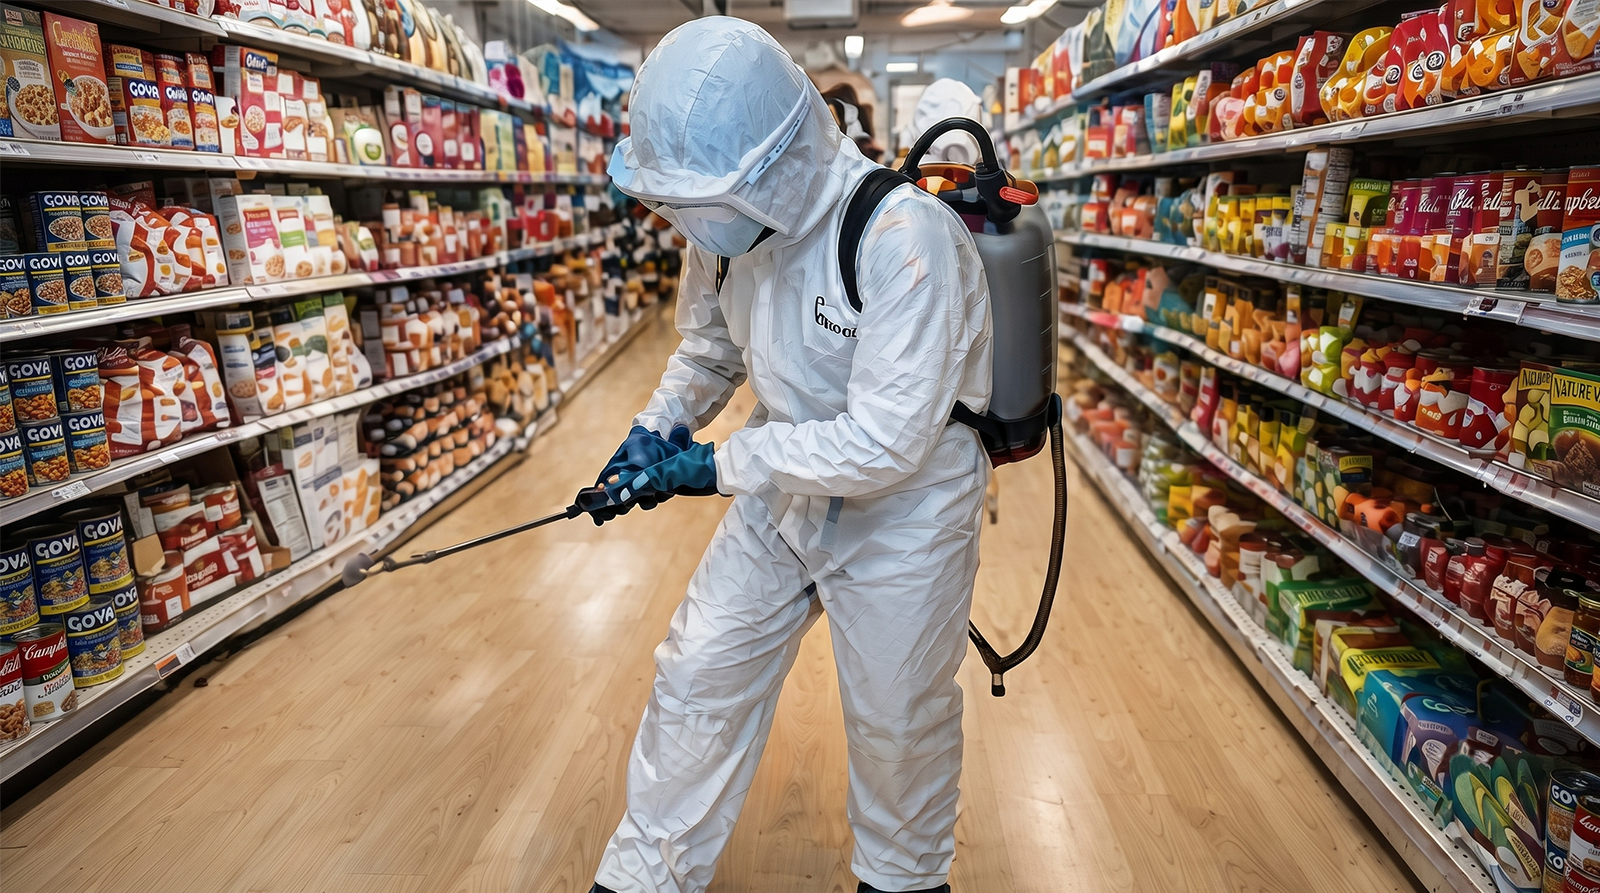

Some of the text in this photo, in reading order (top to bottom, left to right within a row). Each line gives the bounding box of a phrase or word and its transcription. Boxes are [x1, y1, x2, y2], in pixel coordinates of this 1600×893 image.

[30, 257, 62, 270] GOY
[1553, 377, 1592, 401] NATURE
[67, 606, 115, 632] GOYA
